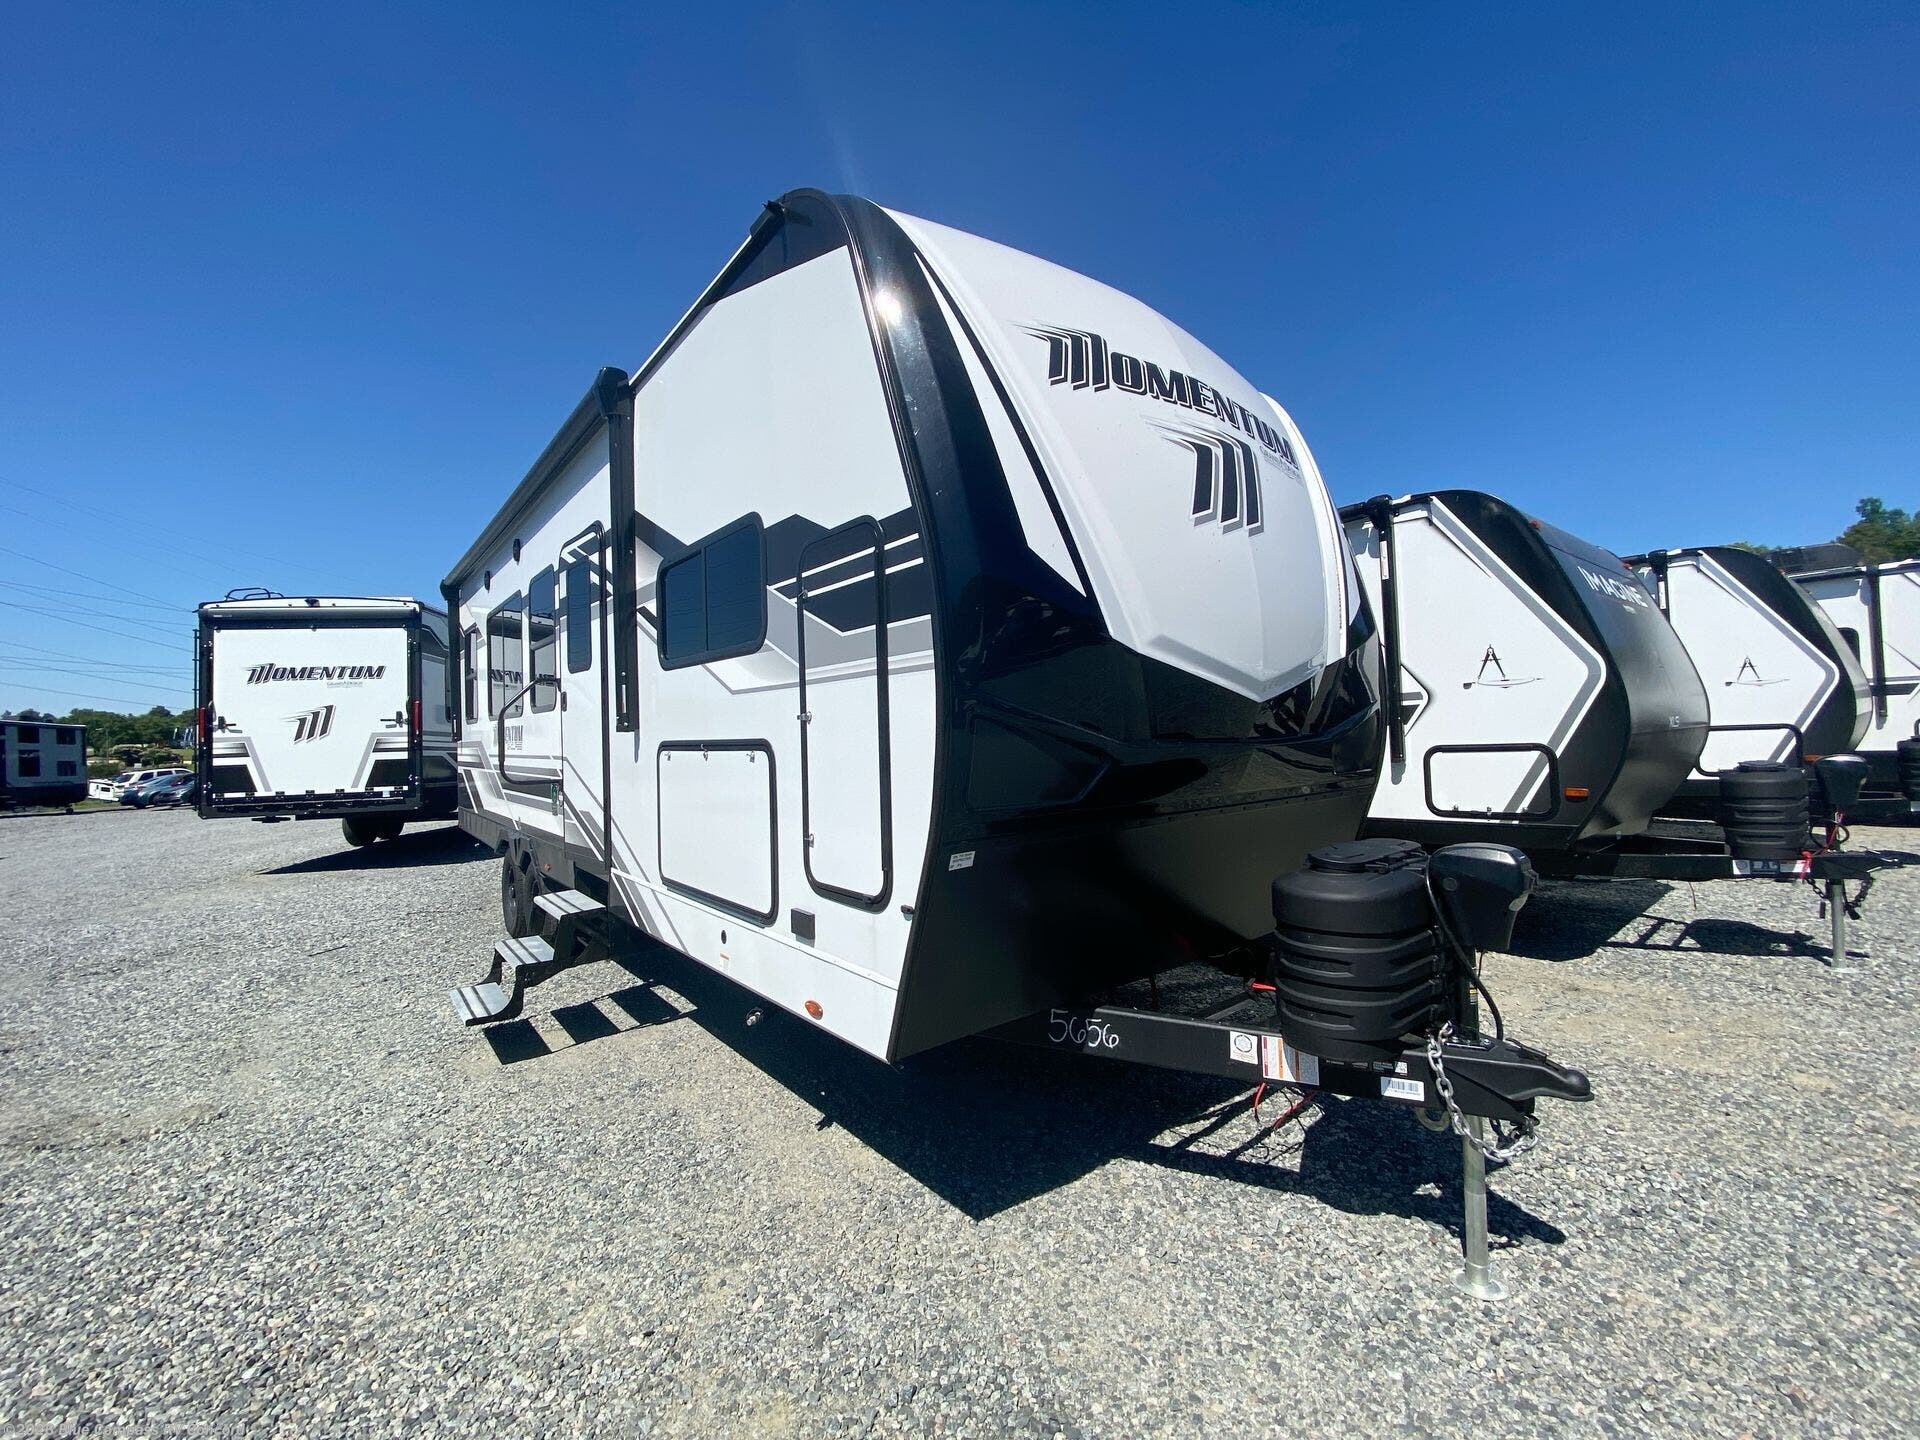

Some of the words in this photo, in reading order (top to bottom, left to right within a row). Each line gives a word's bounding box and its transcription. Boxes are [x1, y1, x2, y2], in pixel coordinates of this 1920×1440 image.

[1012, 319, 1299, 470] MOMENTUM
[246, 662, 386, 685] MOMENTUM
[1048, 1008, 1120, 1048] 5656
